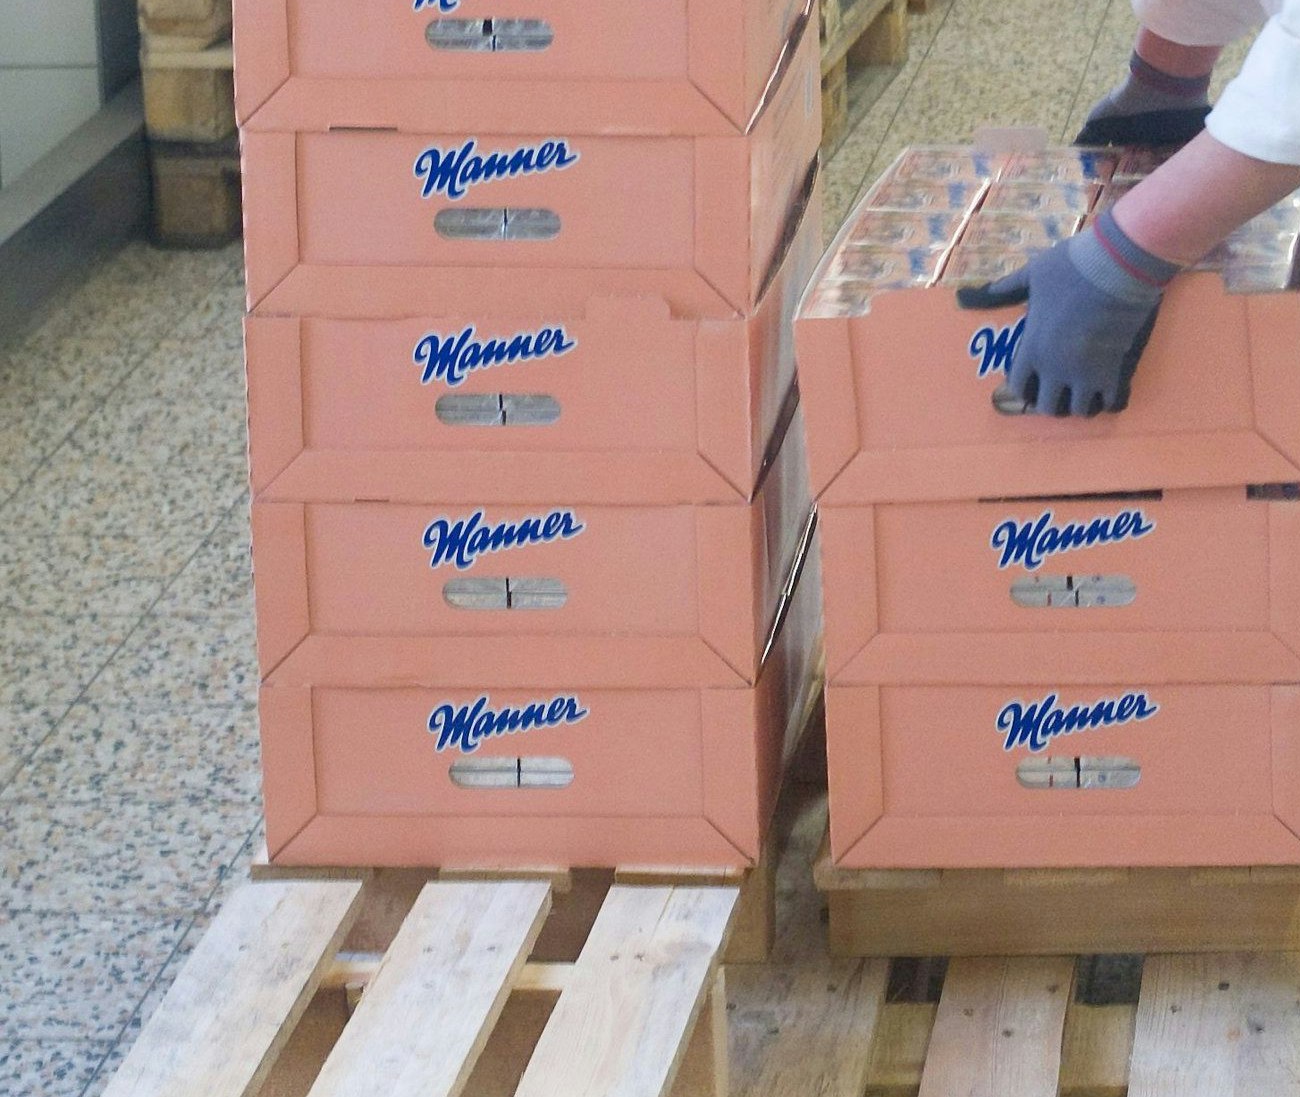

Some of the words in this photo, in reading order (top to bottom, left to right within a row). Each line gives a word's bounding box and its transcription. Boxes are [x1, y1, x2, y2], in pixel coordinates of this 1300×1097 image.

[415, 141, 573, 198] Manner
[414, 328, 573, 384] Manner
[423, 512, 580, 568] Manner
[992, 512, 1152, 568] Manner
[429, 697, 584, 751] Manner
[997, 695, 1155, 750] Manner
